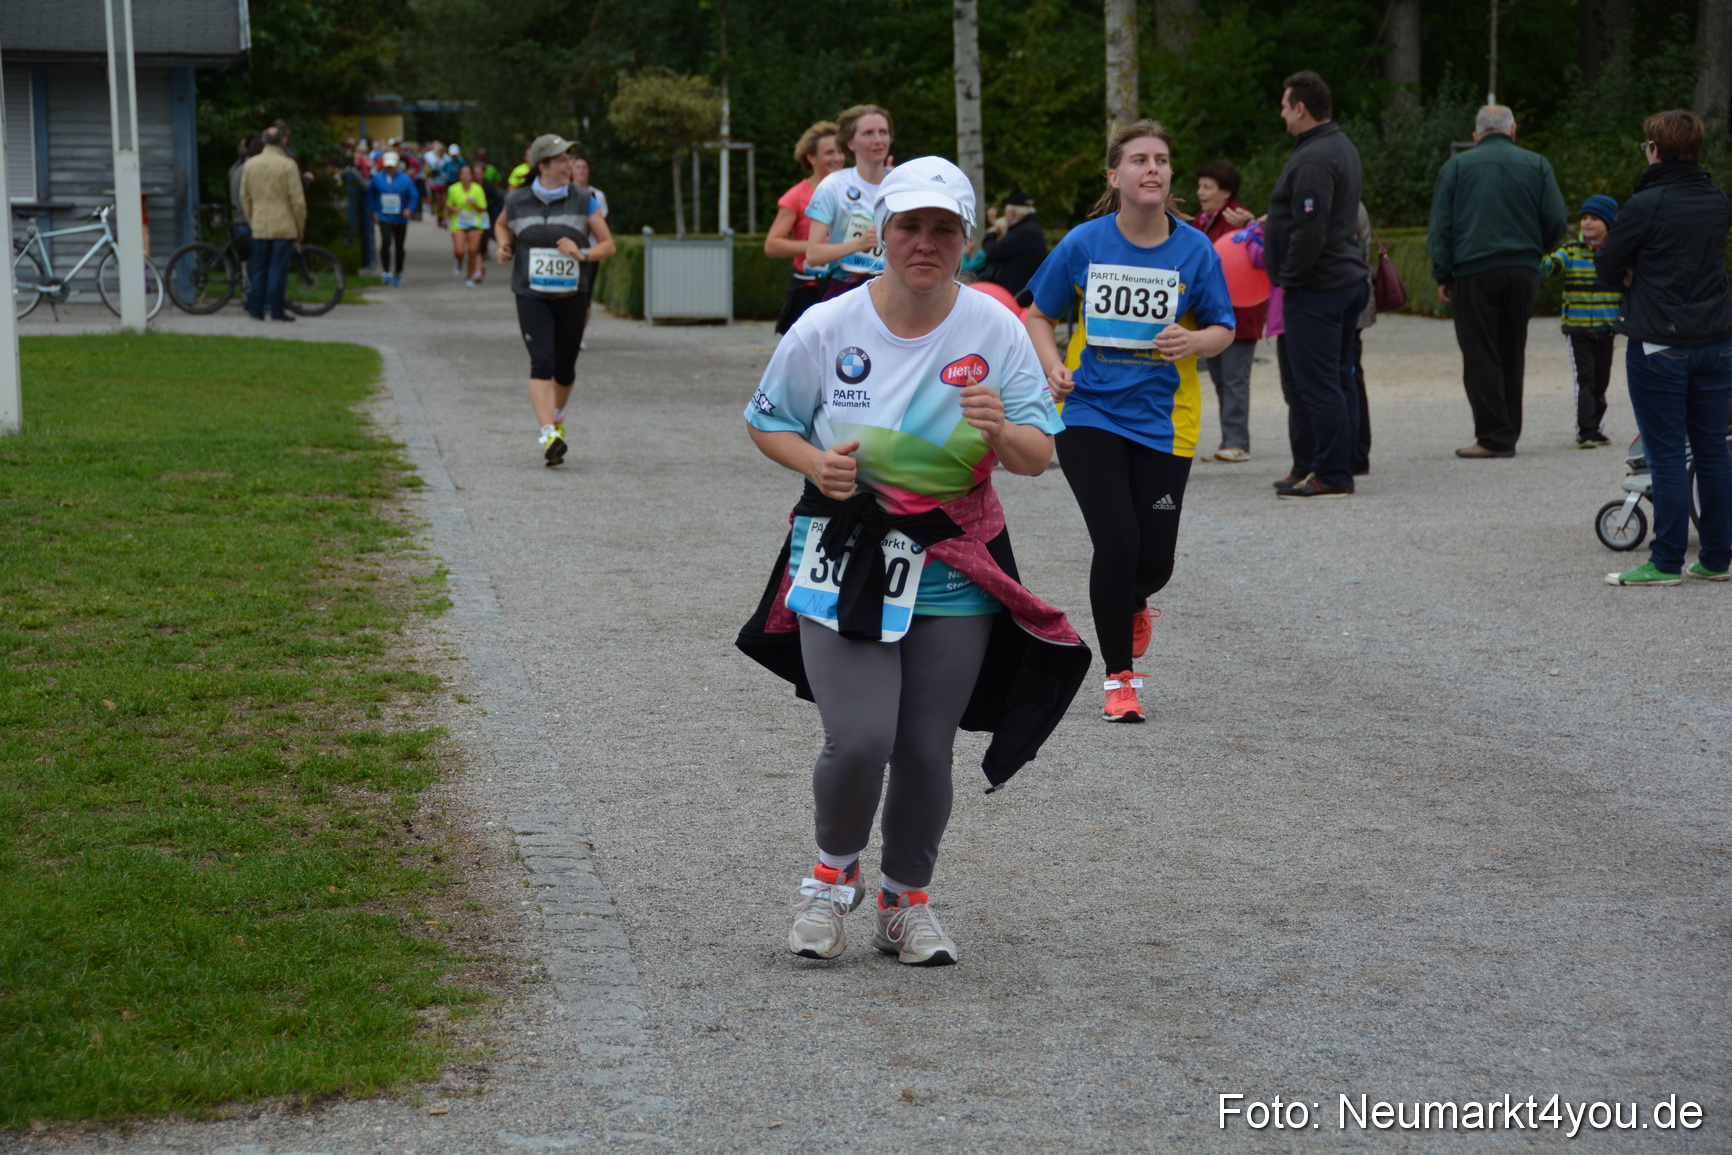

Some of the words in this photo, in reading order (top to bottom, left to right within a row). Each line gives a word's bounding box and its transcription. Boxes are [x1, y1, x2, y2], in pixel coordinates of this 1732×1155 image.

[535, 259, 575, 276] 2492
[1090, 272, 1120, 281] PARTL
[1121, 274, 1164, 285] Neumarkt
[1094, 284, 1169, 320] 3033
[948, 363, 983, 379] Hervis
[834, 389, 871, 400] PARTL
[832, 400, 871, 408] Neumarkt
[810, 541, 911, 599] 300
